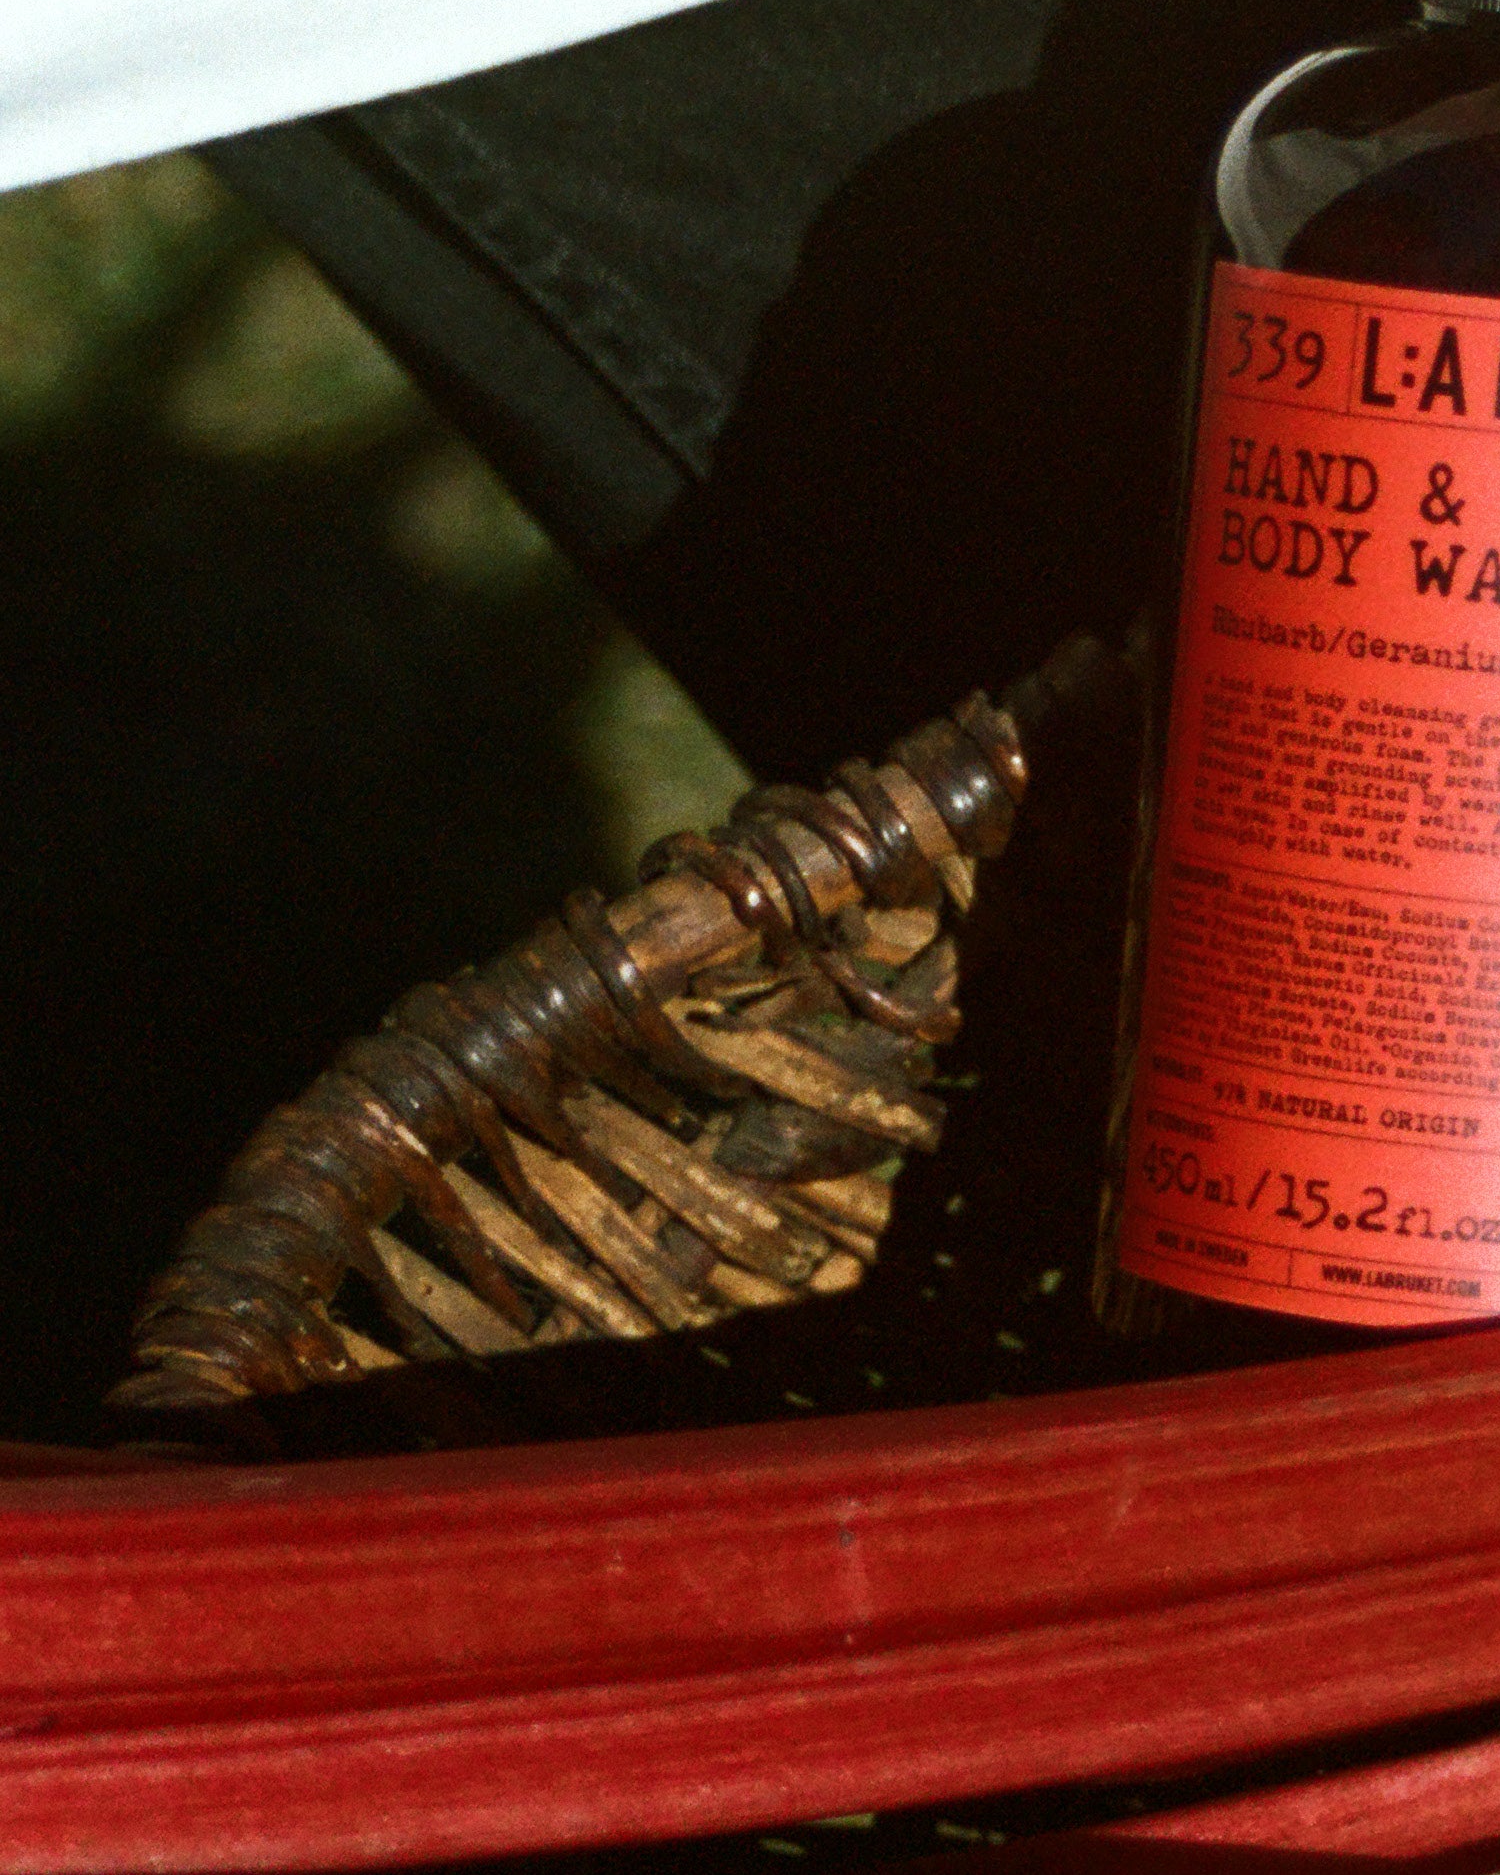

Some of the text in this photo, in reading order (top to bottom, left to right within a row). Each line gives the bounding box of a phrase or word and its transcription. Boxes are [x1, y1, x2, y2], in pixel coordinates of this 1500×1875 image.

[1226, 309, 1326, 389] 339
[1360, 317, 1468, 417] L:A
[1222, 437, 1464, 527] HAND &
[1217, 508, 1370, 587] BODY
[1357, 697, 1467, 728] cleansing
[1276, 728, 1364, 759] generous
[1374, 742, 1433, 764] foam.
[1446, 750, 1485, 770] The
[1342, 716, 1413, 745] gentle
[1464, 732, 1500, 749] the
[1325, 758, 1432, 789] grounding
[1303, 774, 1409, 808] amplified
[1319, 821, 1365, 840] case
[1377, 828, 1402, 846] of
[1348, 803, 1406, 824] rinse
[1418, 812, 1480, 833] well.
[1341, 845, 1413, 870] water.
[1257, 1088, 1368, 1125] NATURAL
[1378, 1109, 1480, 1138] ORIGIN
